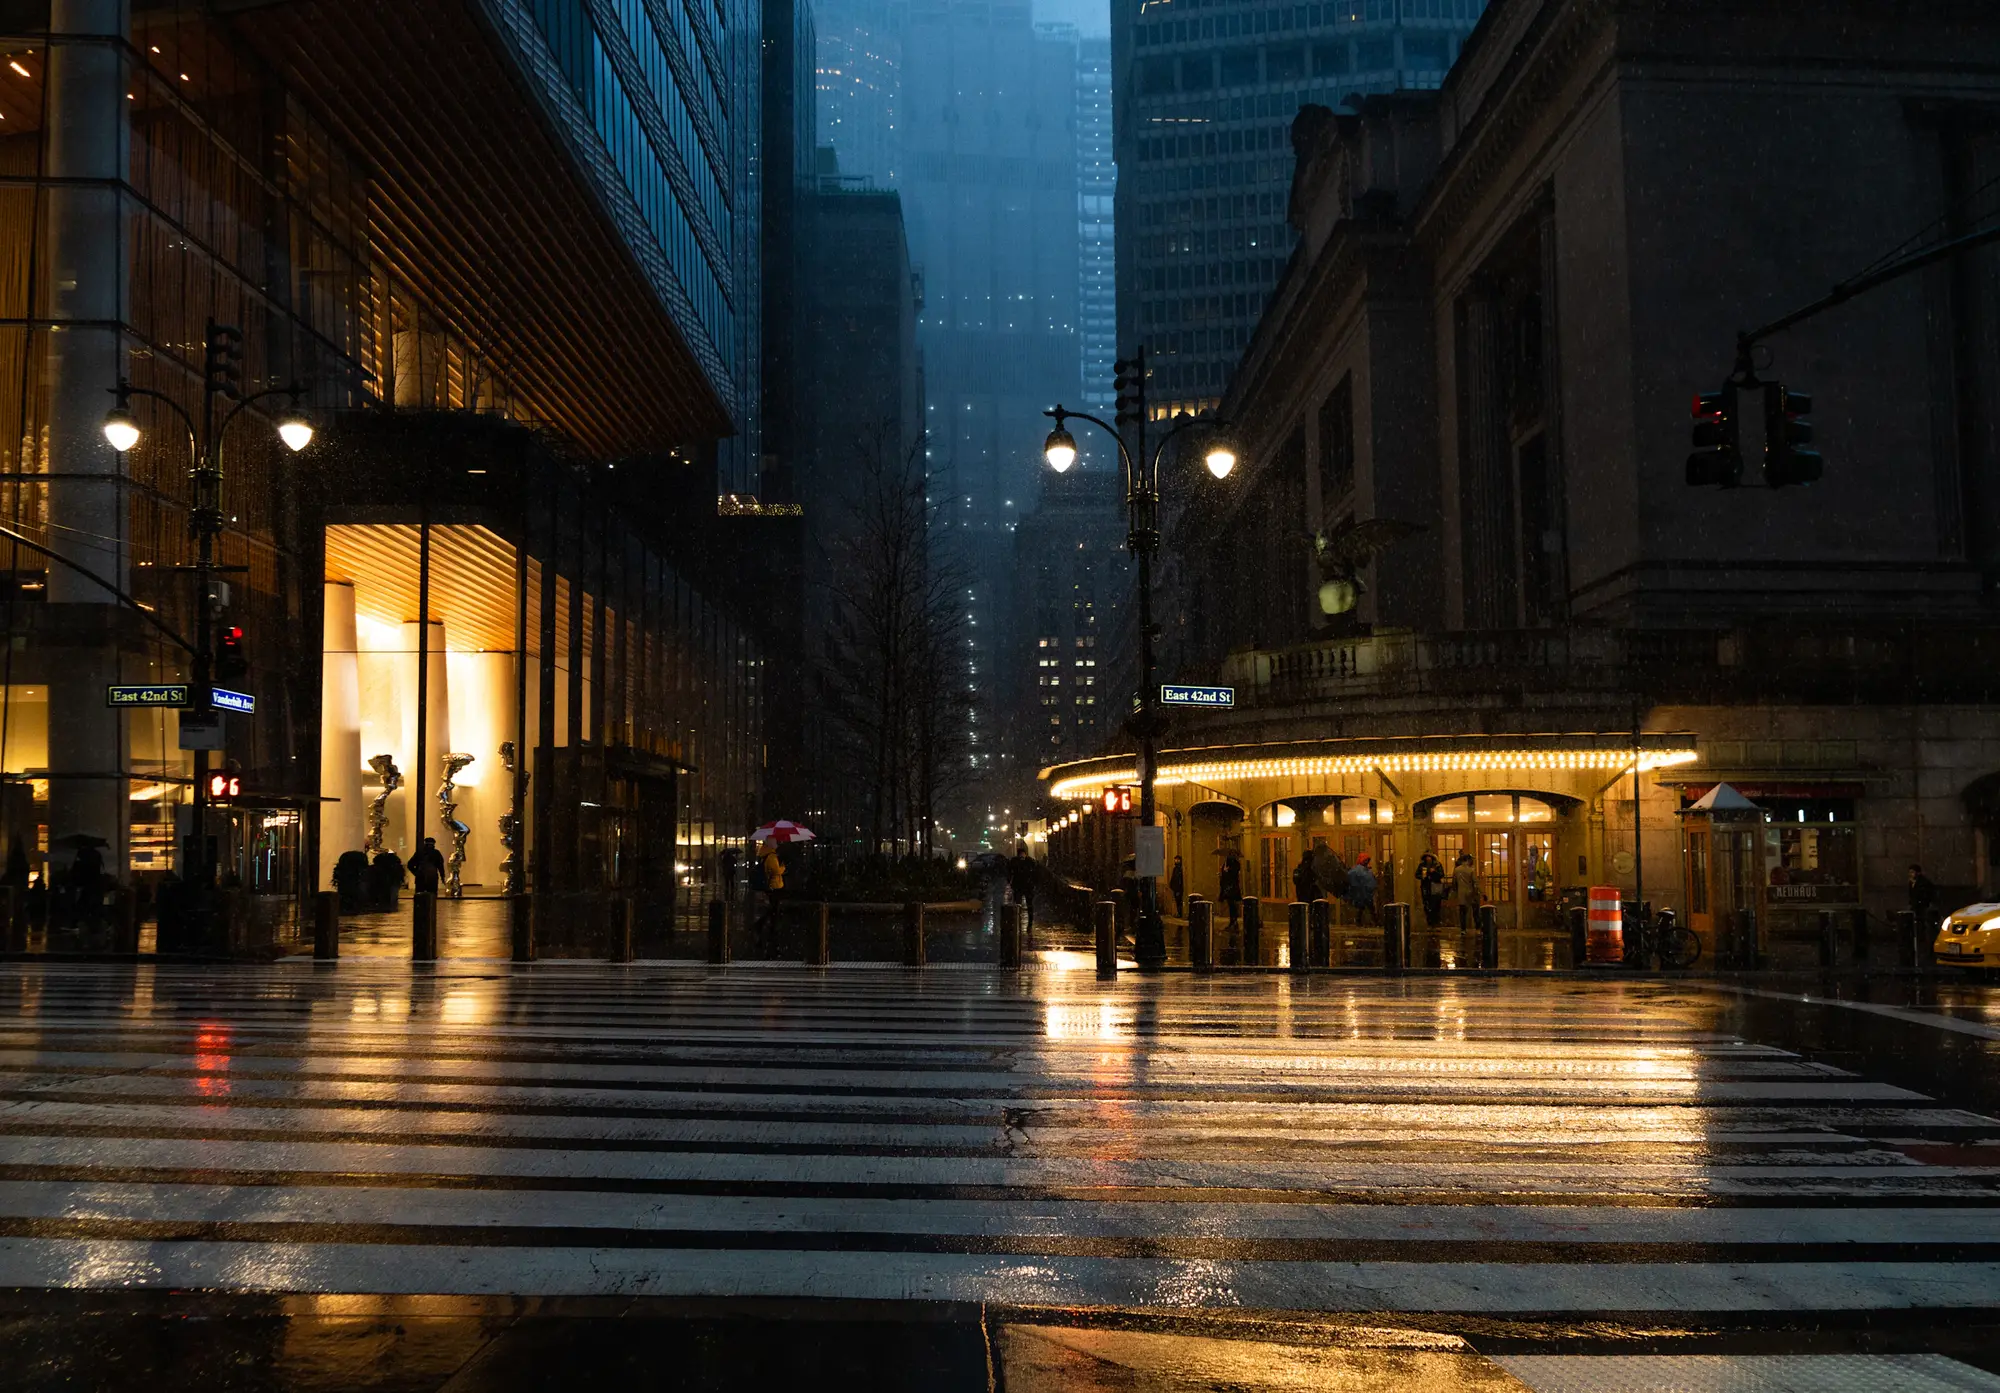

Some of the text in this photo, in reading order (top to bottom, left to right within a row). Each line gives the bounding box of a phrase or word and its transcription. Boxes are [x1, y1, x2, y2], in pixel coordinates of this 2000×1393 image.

[113, 690, 183, 701] East 42nd St
[1165, 689, 1231, 702] East 42nd St
[242, 699, 254, 710] Ave
[229, 778, 240, 796] 6
[1121, 792, 1131, 811] 6
[1776, 886, 1817, 898] NEUHAUS
